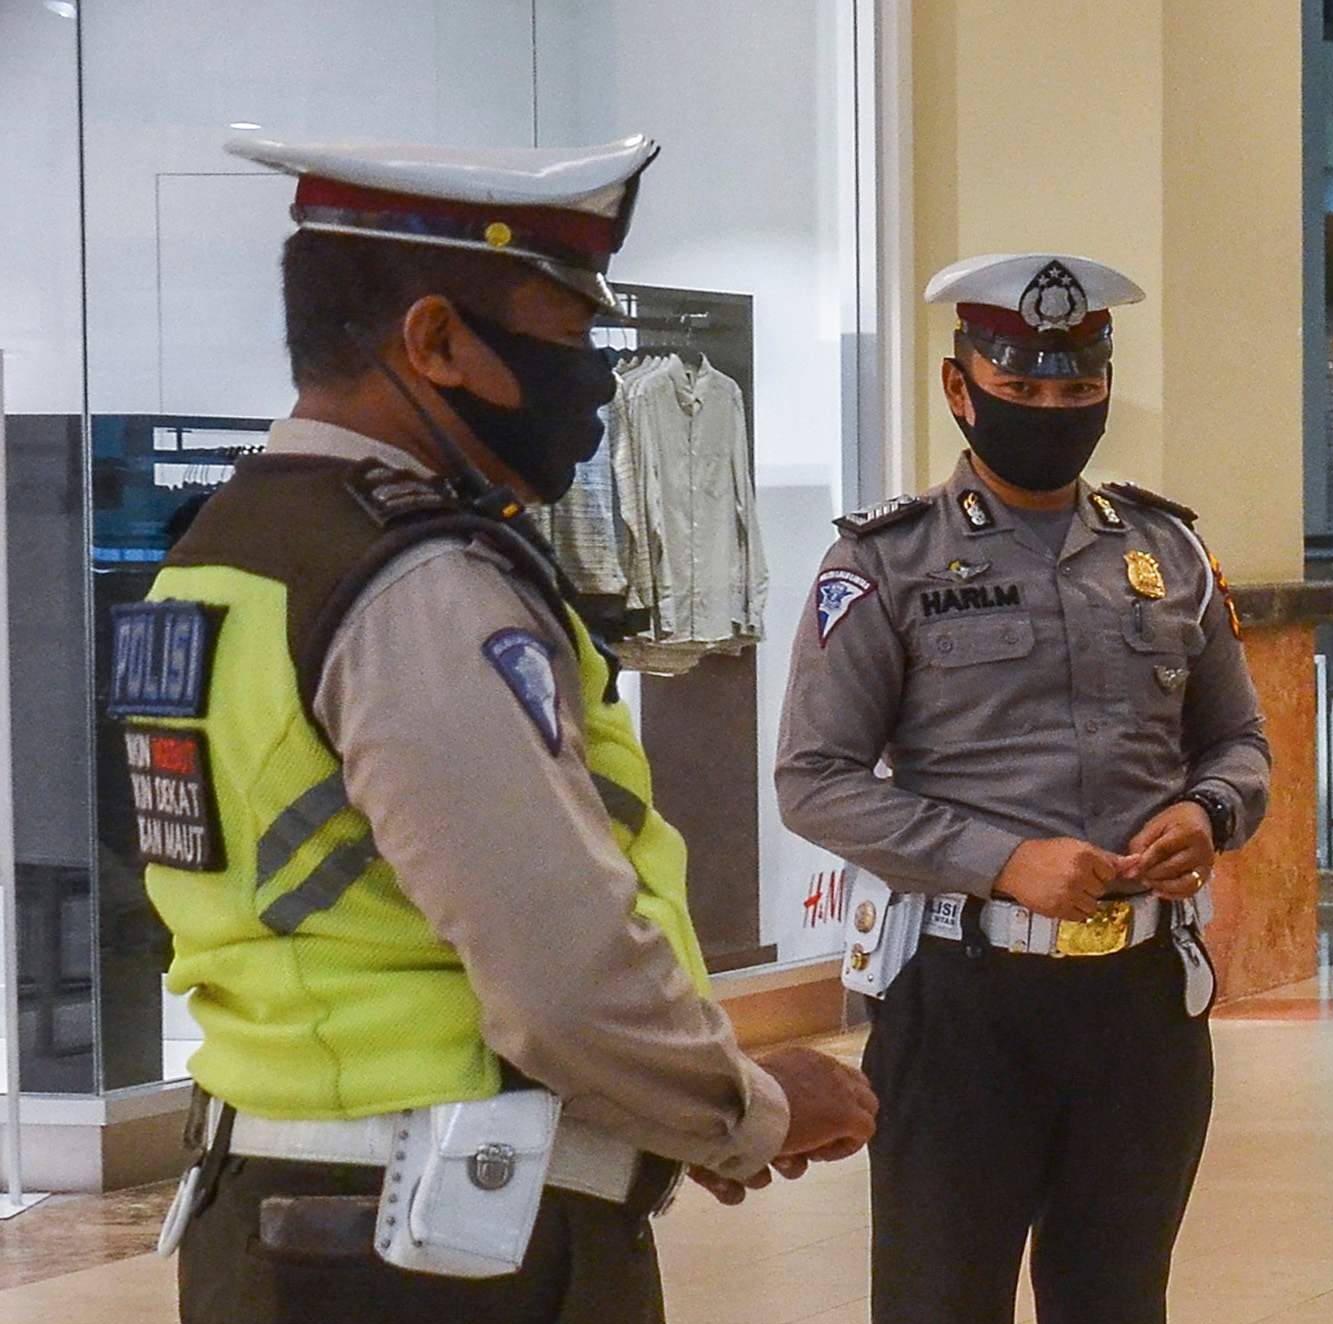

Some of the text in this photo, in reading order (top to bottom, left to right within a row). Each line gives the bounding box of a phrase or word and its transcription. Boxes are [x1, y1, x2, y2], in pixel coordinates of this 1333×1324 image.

[115, 613, 201, 700] POLISI
[163, 820, 204, 865] MAUT
[931, 902, 957, 917] ISI
